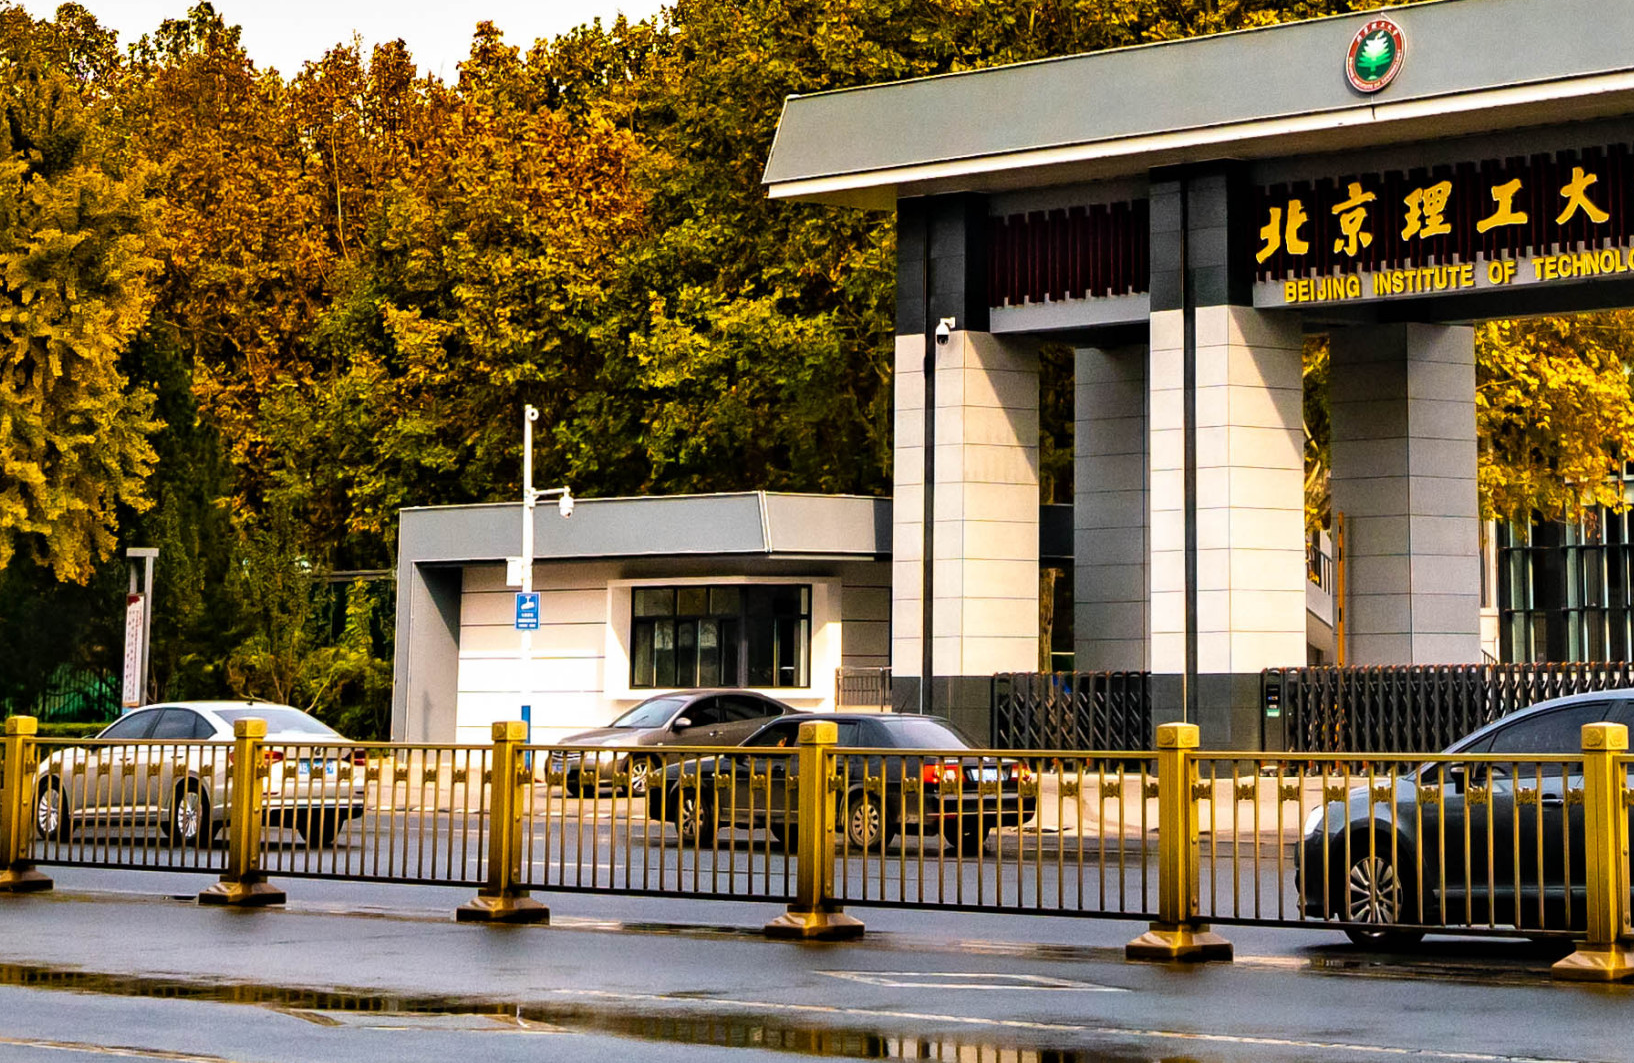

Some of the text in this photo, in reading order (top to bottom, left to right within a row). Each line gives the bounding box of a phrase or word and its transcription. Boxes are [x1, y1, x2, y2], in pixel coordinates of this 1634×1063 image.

[1284, 274, 1361, 303] BEIJING
[1373, 264, 1475, 296] INSTITUTE
[1488, 260, 1517, 285] OF
